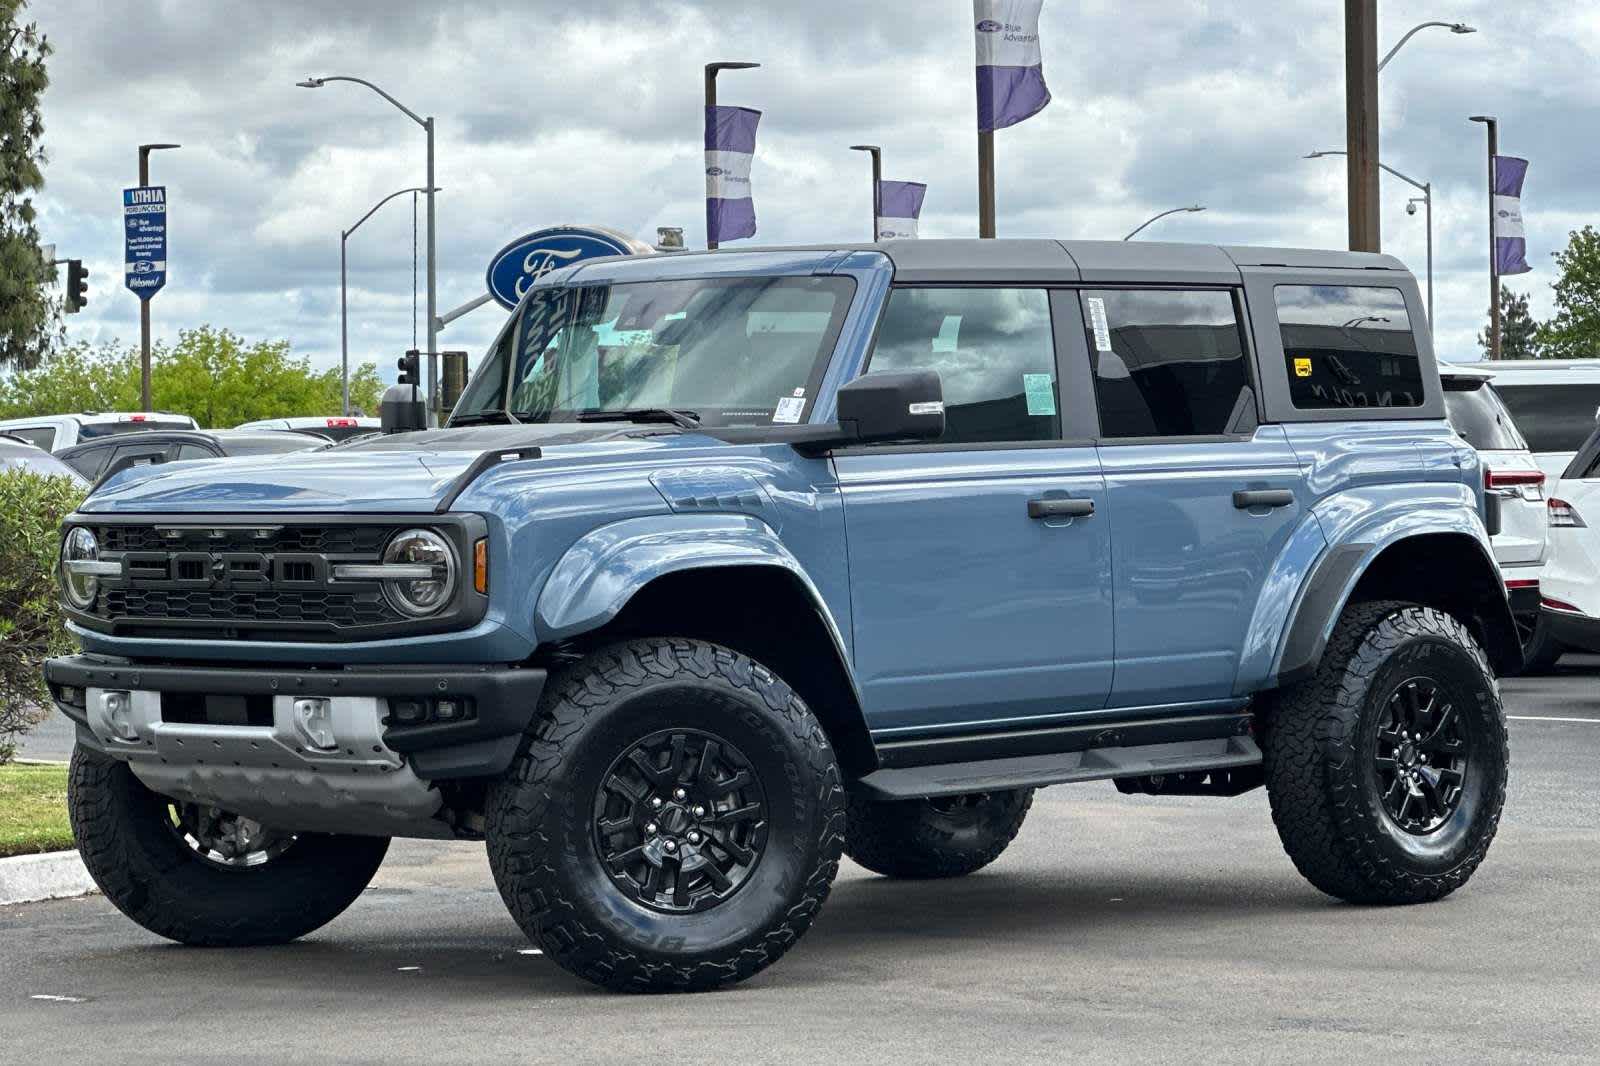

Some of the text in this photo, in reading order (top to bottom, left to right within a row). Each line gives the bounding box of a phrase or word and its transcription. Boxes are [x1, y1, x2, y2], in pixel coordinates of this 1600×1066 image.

[1005, 23, 1021, 32] Blue
[132, 190, 163, 203] LITHIA
[121, 552, 328, 591] FORD
